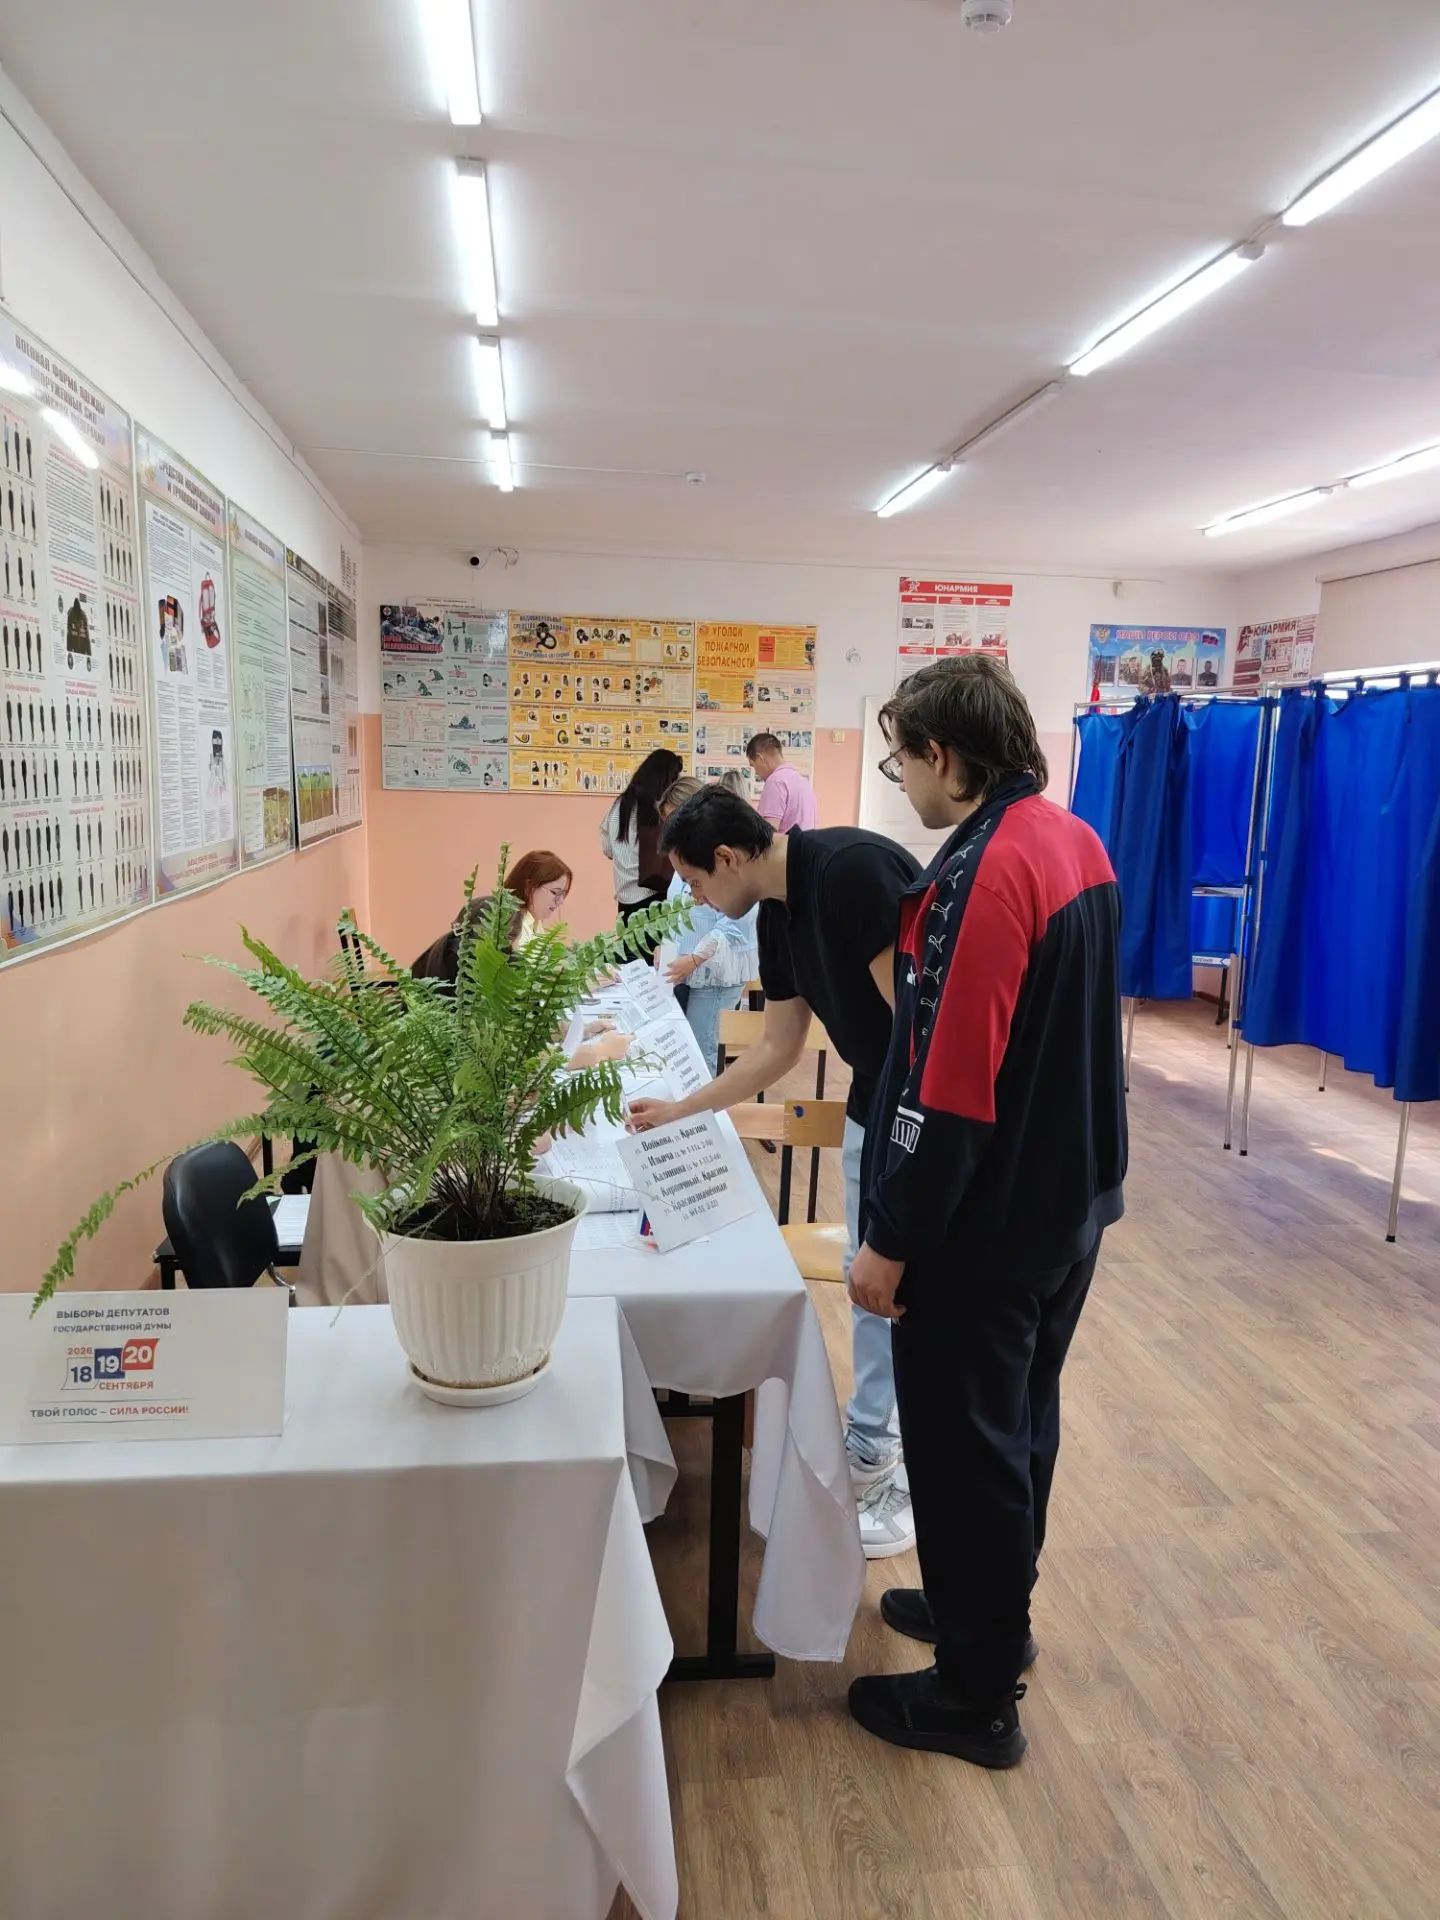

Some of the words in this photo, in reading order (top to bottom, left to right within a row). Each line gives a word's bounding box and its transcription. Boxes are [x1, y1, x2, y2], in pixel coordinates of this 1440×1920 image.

[52, 360, 78, 393] ФОРМА
[935, 584, 978, 593] ЮНАРМИЯ
[712, 626, 744, 638] УГОЛОК
[1253, 620, 1297, 637] ЮНАРМИЯ
[705, 641, 750, 653] ПОЖАРНОЙ
[697, 655, 755, 668] БЕЗОПАСНОСТИ
[680, 1123, 708, 1139] Красина
[652, 1164, 686, 1183] Калинина
[701, 1165, 729, 1181] Красина
[56, 1310, 105, 1319] ВЫБОРЫ
[106, 1307, 170, 1318] ДЕПУТАТОВ
[53, 1322, 142, 1333] ГОСУДАРСТВЕННОЙ
[143, 1323, 172, 1332] ДУМЫ
[67, 1347, 93, 1355] 2026
[124, 1346, 151, 1364] 20
[97, 1355, 120, 1374] 19
[70, 1365, 93, 1383] 18
[99, 1381, 154, 1391] СЕНТЯБРЯ
[30, 1408, 60, 1418] ТВОЙ
[62, 1407, 98, 1417] ГОЛОС
[109, 1407, 139, 1416] СИЛА
[142, 1405, 189, 1416] РОССИИ!
